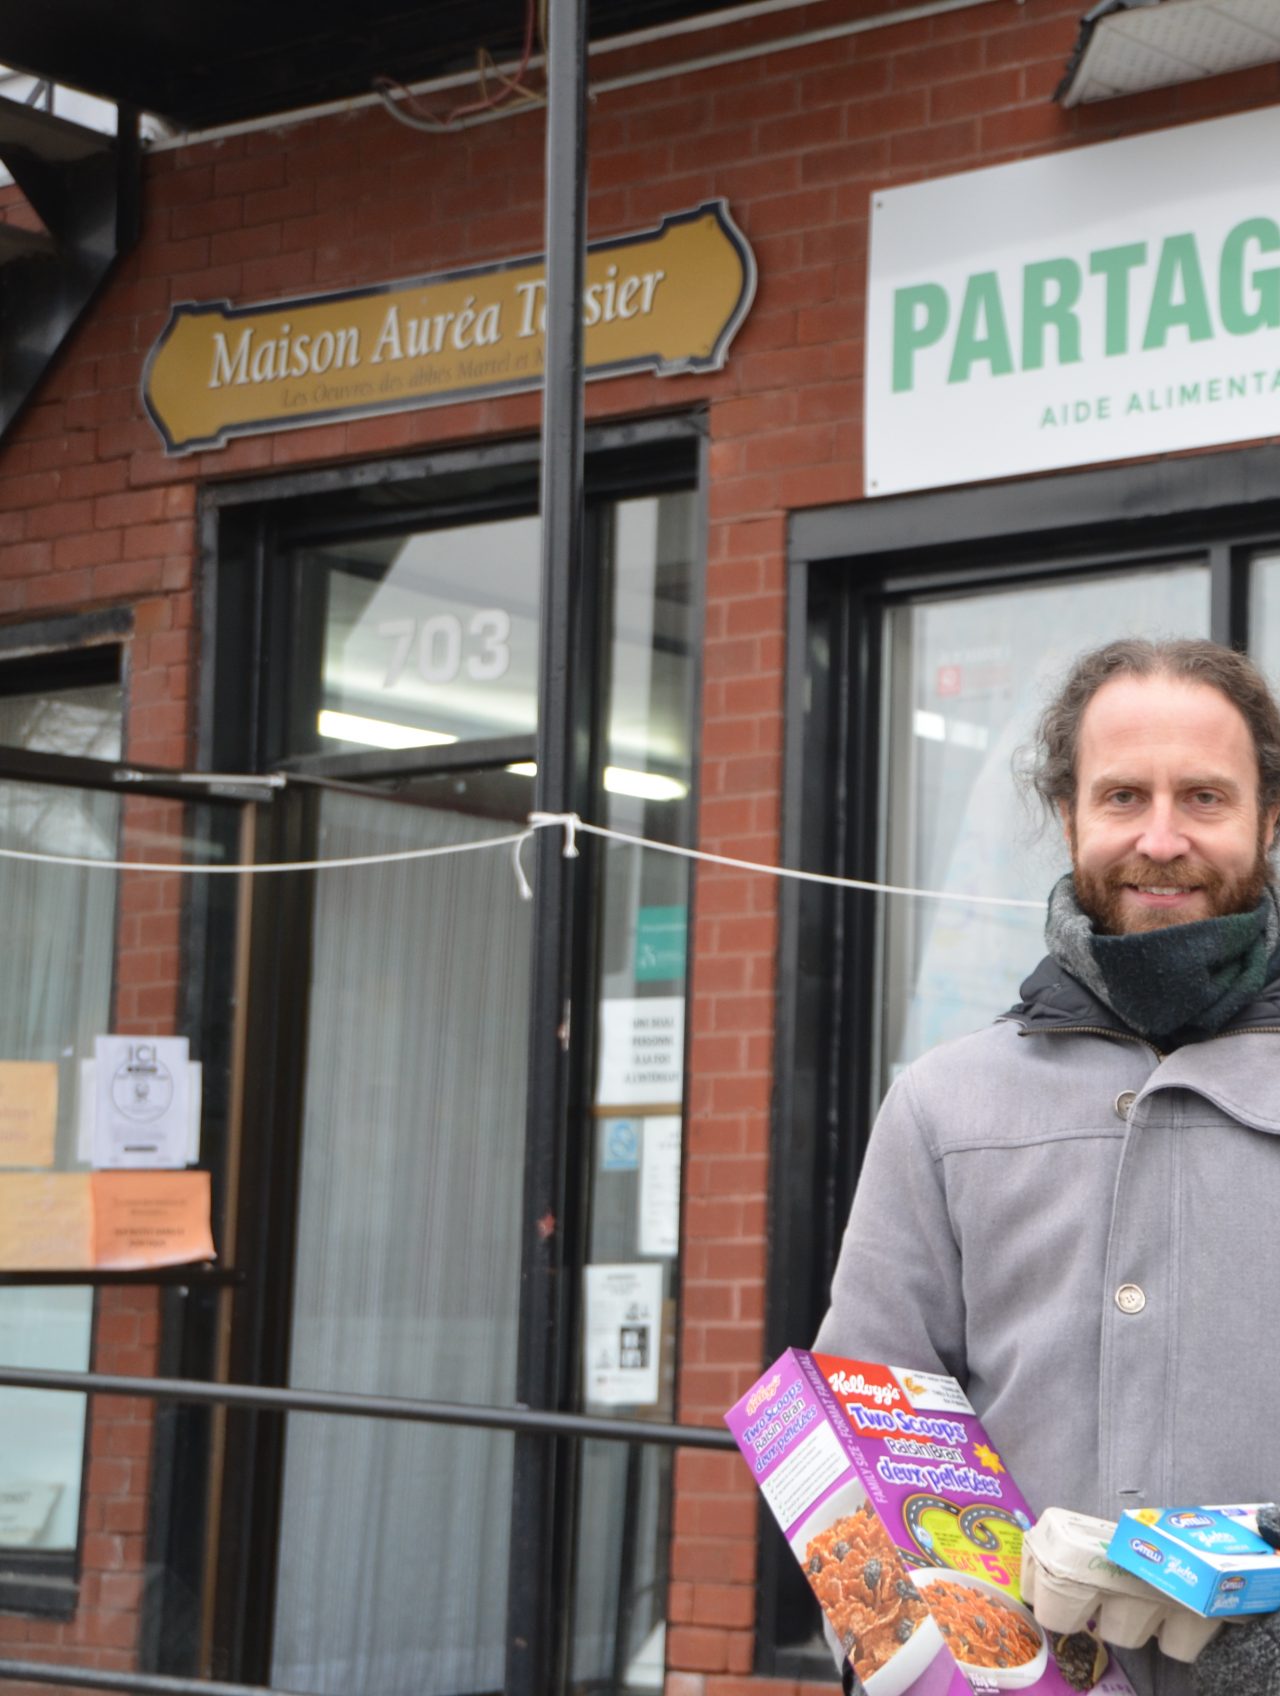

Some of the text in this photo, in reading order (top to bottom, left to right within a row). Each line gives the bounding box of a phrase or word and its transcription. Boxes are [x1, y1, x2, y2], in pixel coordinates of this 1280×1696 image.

[208, 264, 665, 388] Maison Auréa Tsier
[379, 371, 404, 393] des
[1040, 398, 1111, 428] AIDE
[379, 608, 511, 688] 703
[828, 1370, 900, 1405] Kellogg's
[743, 1418, 766, 1444] Two
[764, 1379, 803, 1423] Scoops
[754, 1398, 805, 1452] Raisin Bran
[847, 1403, 968, 1444] Two Scoops
[755, 1443, 779, 1474] deux
[848, 1443, 869, 1468] SIZE
[886, 1437, 964, 1463] Raisin Bran
[860, 1467, 888, 1504] FAMILY
[878, 1457, 1002, 1498] deux pelletées
[1169, 1513, 1214, 1529] CATELLI
[1131, 1539, 1162, 1563] CATELLI
